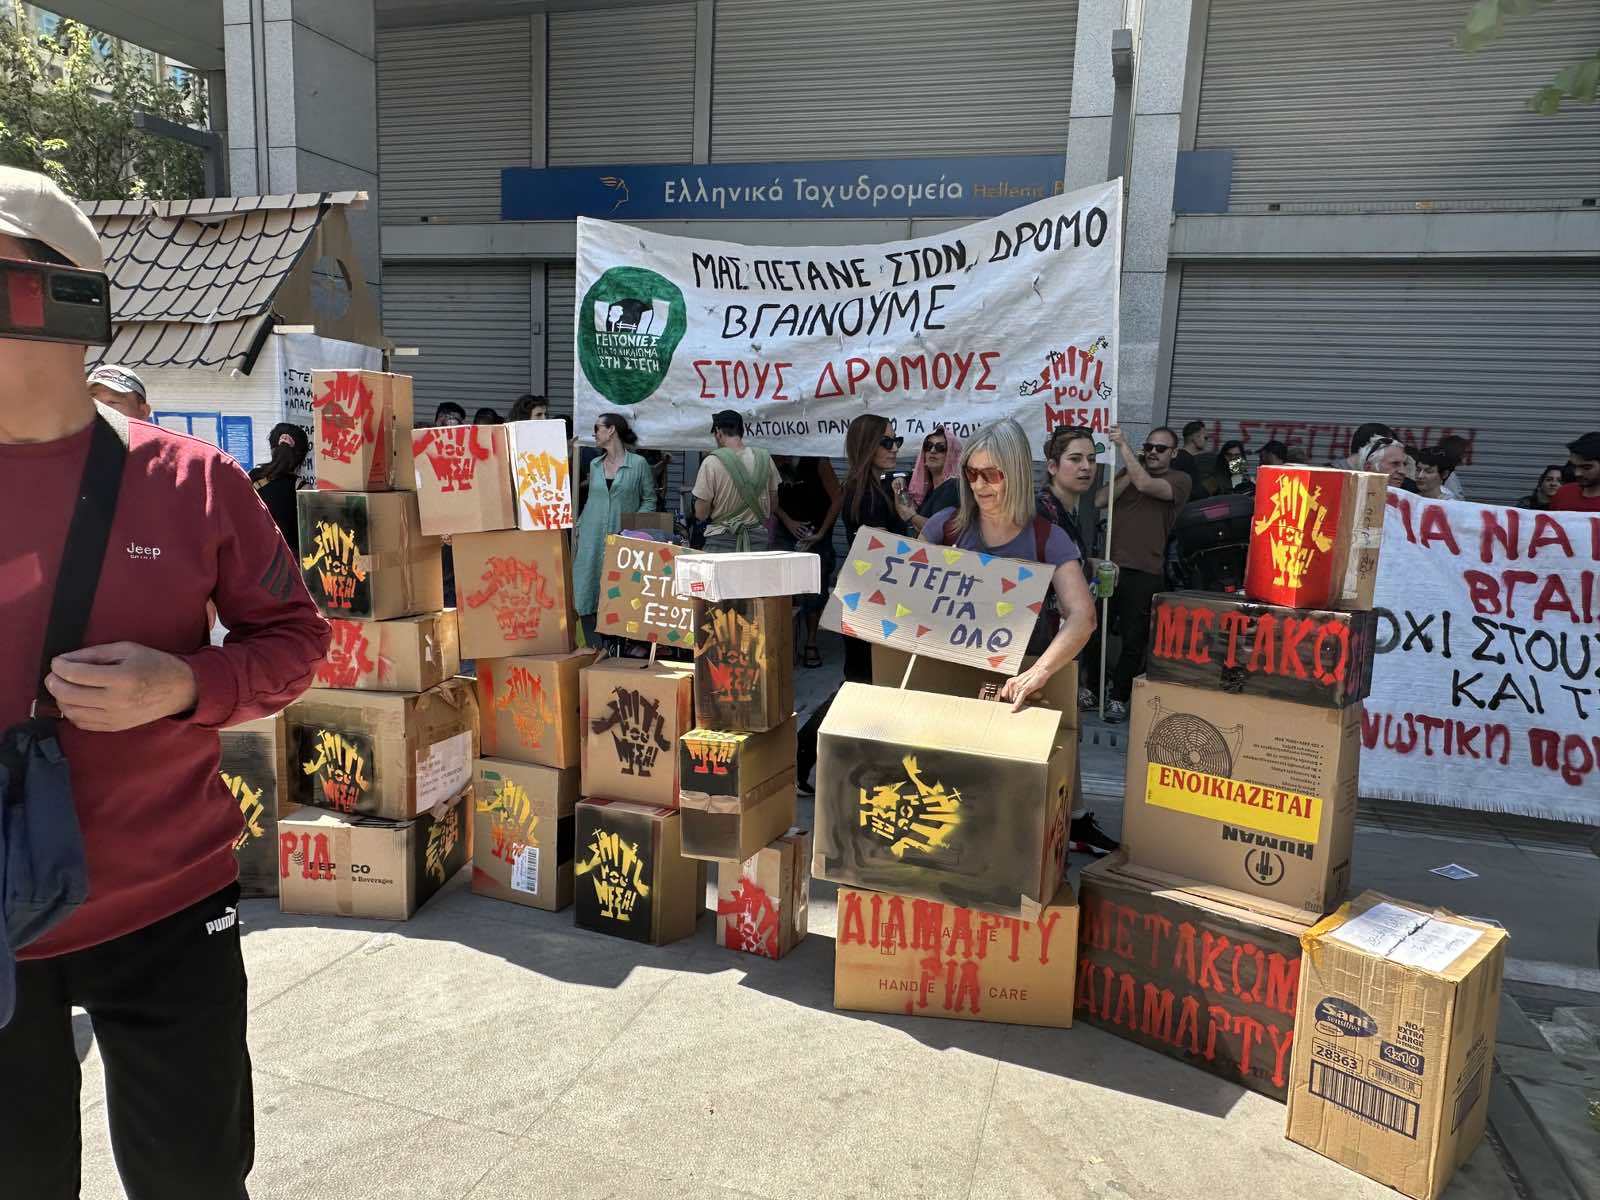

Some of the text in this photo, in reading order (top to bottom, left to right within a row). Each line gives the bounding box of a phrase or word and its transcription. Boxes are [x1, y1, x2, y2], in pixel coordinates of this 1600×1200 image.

[664, 174, 963, 208] Ελληνικά Ταχυδρομεία
[692, 206, 1108, 291] ΜΑΣ ΠΕΤΑΝΕ ΣΤΟΝ ΔΡΟΜΟ
[721, 284, 956, 340] ΒΓΑΙΝΟΥΜΕ
[595, 333, 660, 347] ΓΕΙΤΟΝΙΕΣ
[599, 355, 659, 372] ΣΤΗ ΣΤΕΓΗ
[692, 350, 1001, 400] ΣΤΟΥΣ ΔΡΟΜΟΥΣ
[744, 420, 810, 437] ΚΑΤΟΙΚΟΙ
[817, 418, 850, 434] ΠΑΝ
[906, 419, 925, 434] ΤΑ
[126, 541, 161, 558] Jeep
[1481, 509, 1574, 564] ΝΑ
[617, 546, 653, 572] ΟΧΙ
[879, 555, 983, 598] ΣΤΕΓΗ
[931, 595, 976, 620] ΓΙΑ
[1464, 569, 1600, 624] ΒΓΑΙ
[1373, 606, 1600, 681] ΟΧΙ ΣΤΟΥ
[1452, 669, 1545, 714] ΚΑΙ
[1159, 766, 1313, 819] ΕΝΟΙΚΙΑΖΕΤΑΙ
[1222, 824, 1314, 861] HUMAN
[309, 861, 371, 875] PEPCO
[879, 978, 935, 993] HANDE
[989, 986, 1029, 1001] CARE
[1322, 1002, 1368, 1030] Sani
[1327, 1014, 1361, 1033] sensitive
[1396, 1032, 1425, 1048] LARGE
[1397, 1026, 1425, 1041] EXTRA
[1316, 1045, 1358, 1070] 28363
[1384, 1046, 1420, 1068] 4x10
